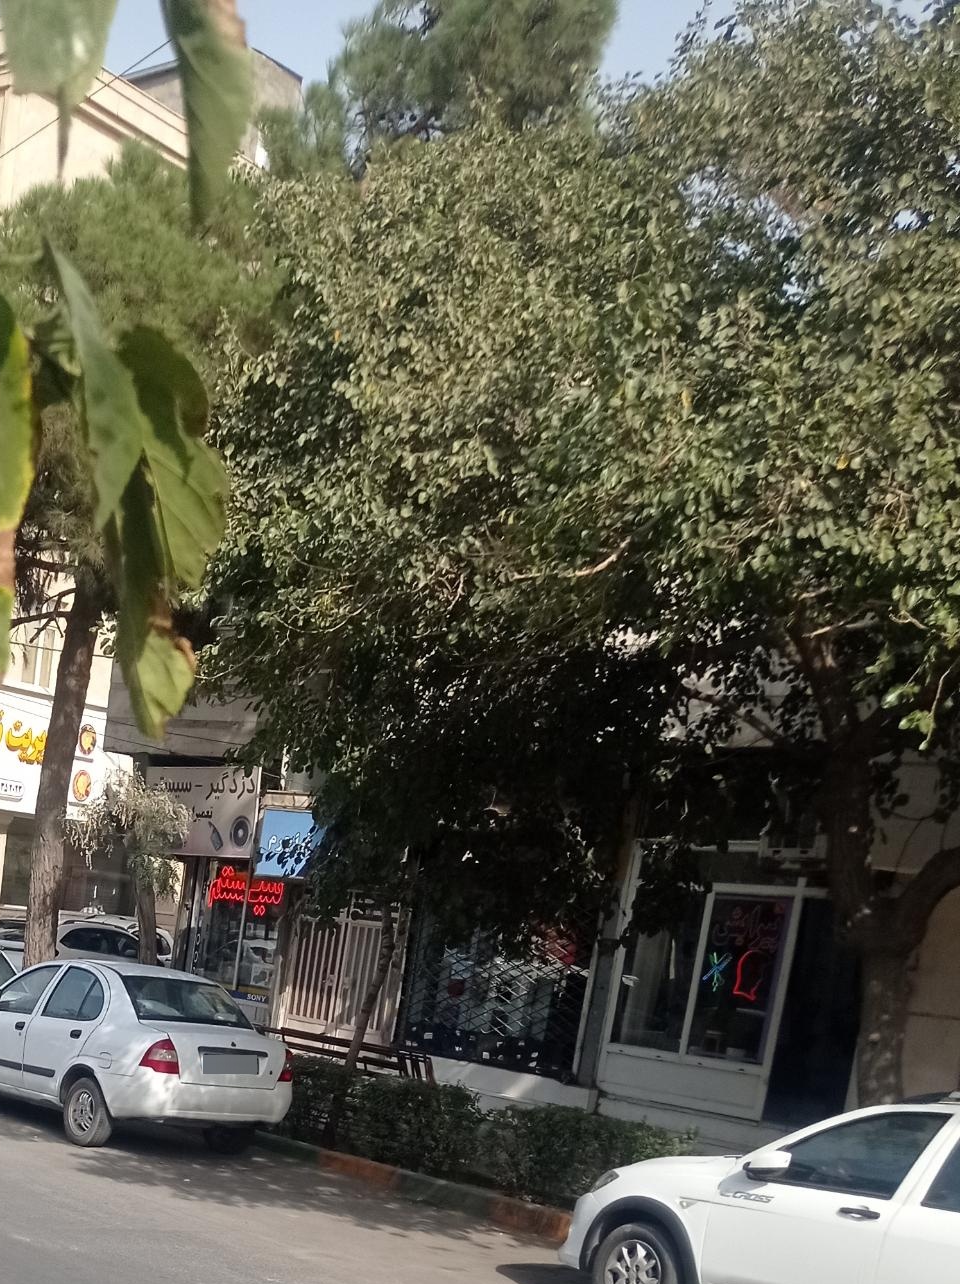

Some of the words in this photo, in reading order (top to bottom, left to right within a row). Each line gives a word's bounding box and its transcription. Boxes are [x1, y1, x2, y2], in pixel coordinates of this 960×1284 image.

[206, 771, 255, 800] دزدگیر
[192, 806, 213, 822] تعمیرا
[247, 993, 267, 1003] SONY
